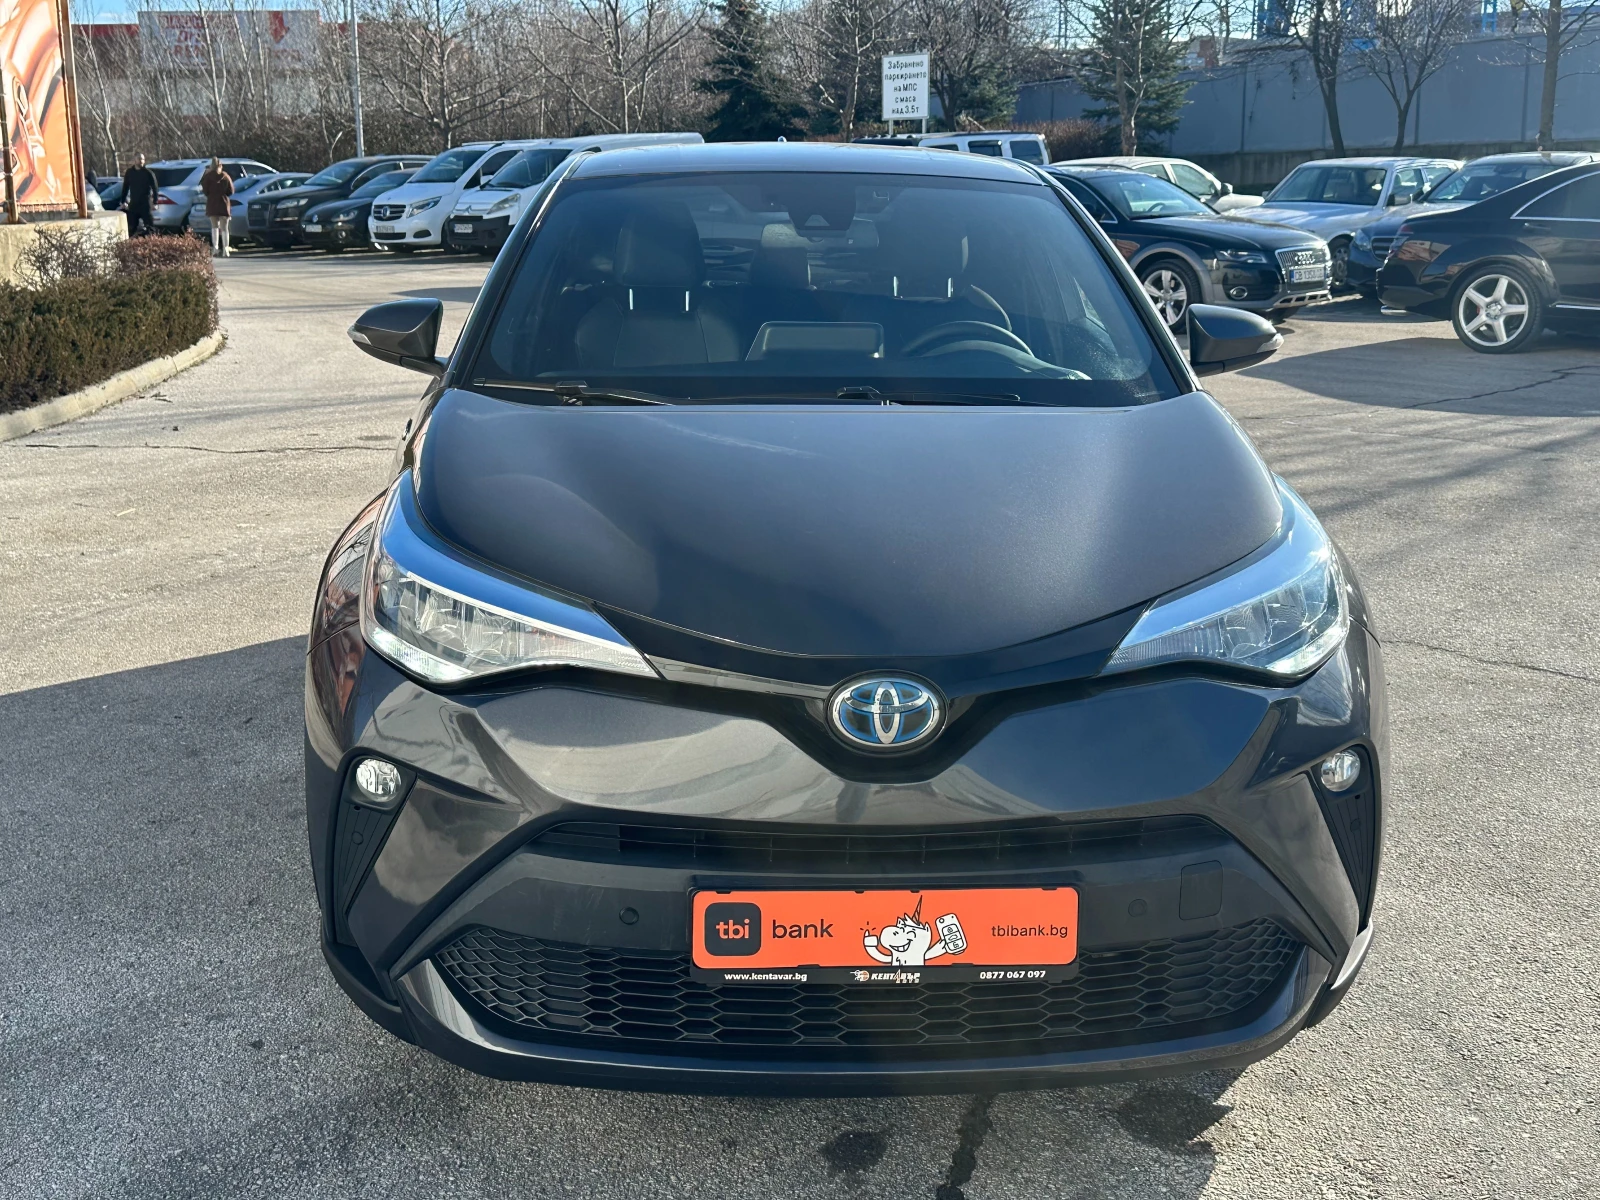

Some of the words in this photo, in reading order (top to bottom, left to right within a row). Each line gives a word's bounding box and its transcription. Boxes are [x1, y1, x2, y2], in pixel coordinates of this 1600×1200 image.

[888, 60, 924, 70] Забранено
[902, 83, 917, 92] МПС
[715, 919, 750, 939] tbi
[772, 918, 834, 939] bank
[991, 924, 1068, 938] tbibank.bg
[724, 972, 808, 982] www.kentavar.bg
[980, 971, 1005, 979] 0877
[1006, 971, 1025, 979] 067
[1027, 970, 1046, 978] 097
